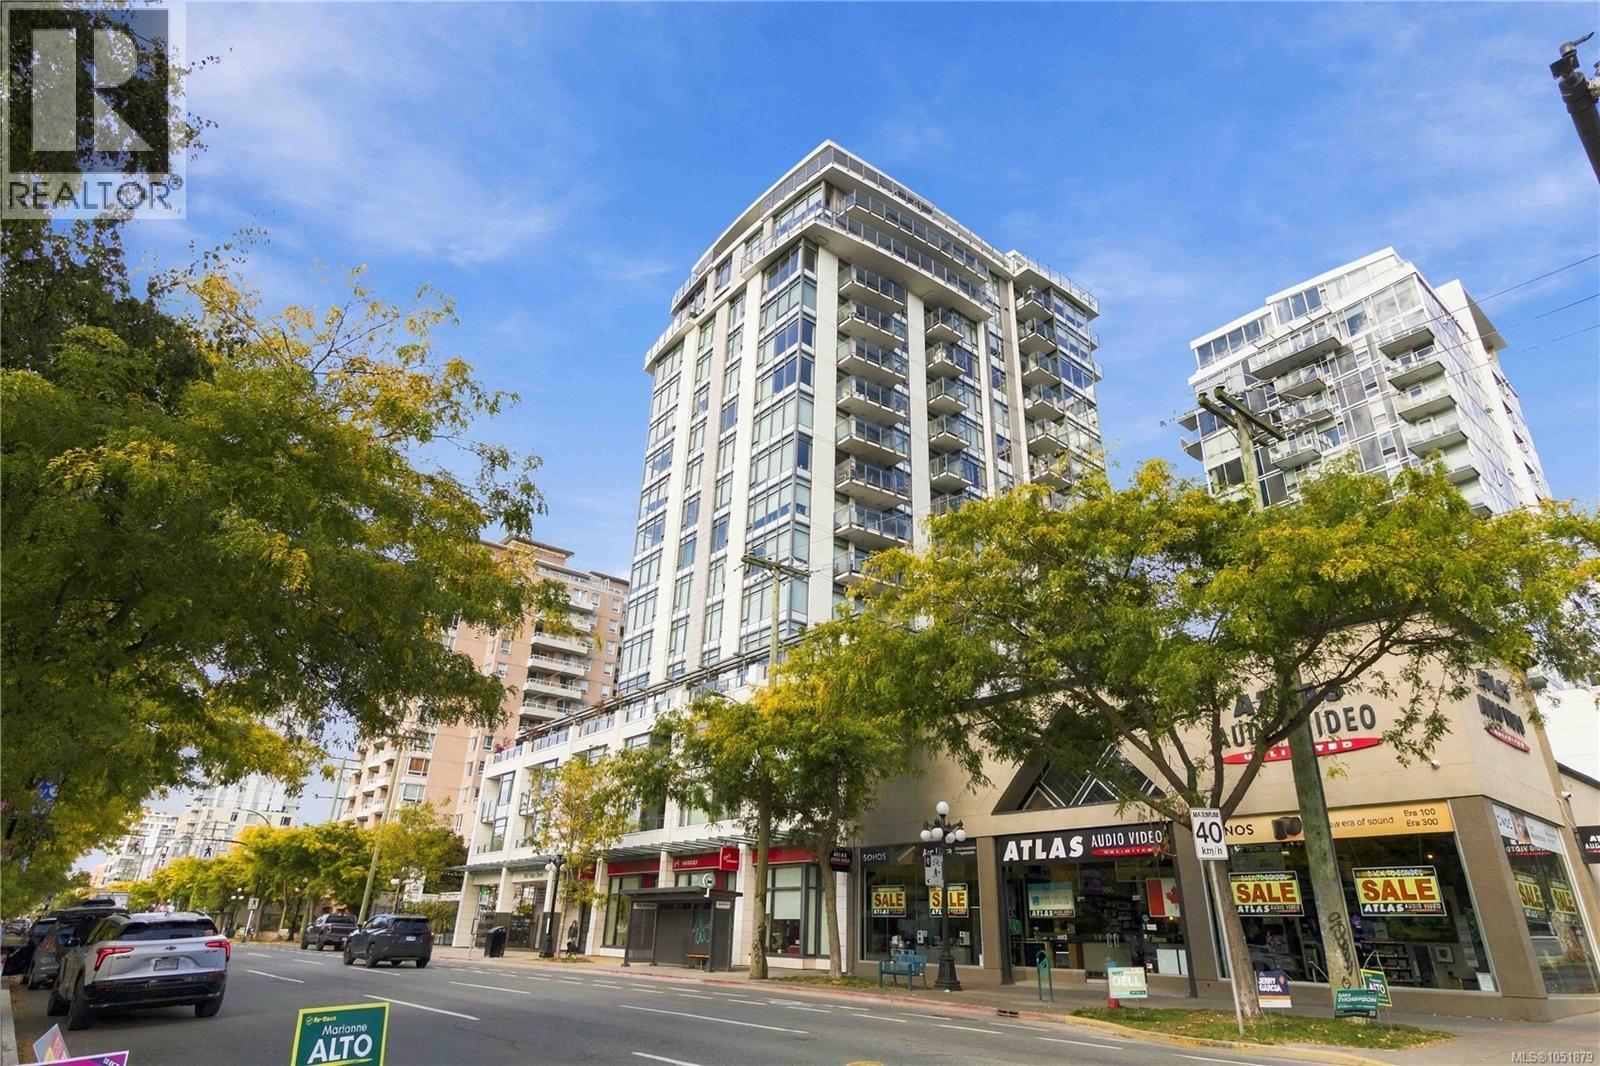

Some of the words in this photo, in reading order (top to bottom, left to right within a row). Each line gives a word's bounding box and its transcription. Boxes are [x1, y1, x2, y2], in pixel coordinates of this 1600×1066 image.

[1309, 703, 1376, 738] IDEO
[1403, 809, 1418, 817] Era
[1420, 808, 1436, 816] 100
[1357, 818, 1366, 826] of
[1367, 816, 1394, 826] sound
[1406, 819, 1420, 827] Era
[1422, 818, 1438, 826] 300
[1196, 821, 1222, 844] 40
[1003, 835, 1084, 862] ATLAS
[1091, 832, 1124, 848] AUDIO
[1128, 830, 1163, 844] VIDEO
[1201, 846, 1223, 856] km/h
[1236, 882, 1297, 904] SALE
[1362, 878, 1436, 901] SALE
[1518, 883, 1544, 908] SALE
[874, 892, 904, 908] SALE
[932, 891, 965, 908] SLE
[1238, 904, 1270, 914] ATLAS
[1364, 903, 1405, 913] ATLAS
[321, 1024, 368, 1036] Marianne
[307, 1034, 373, 1064] ALTO
